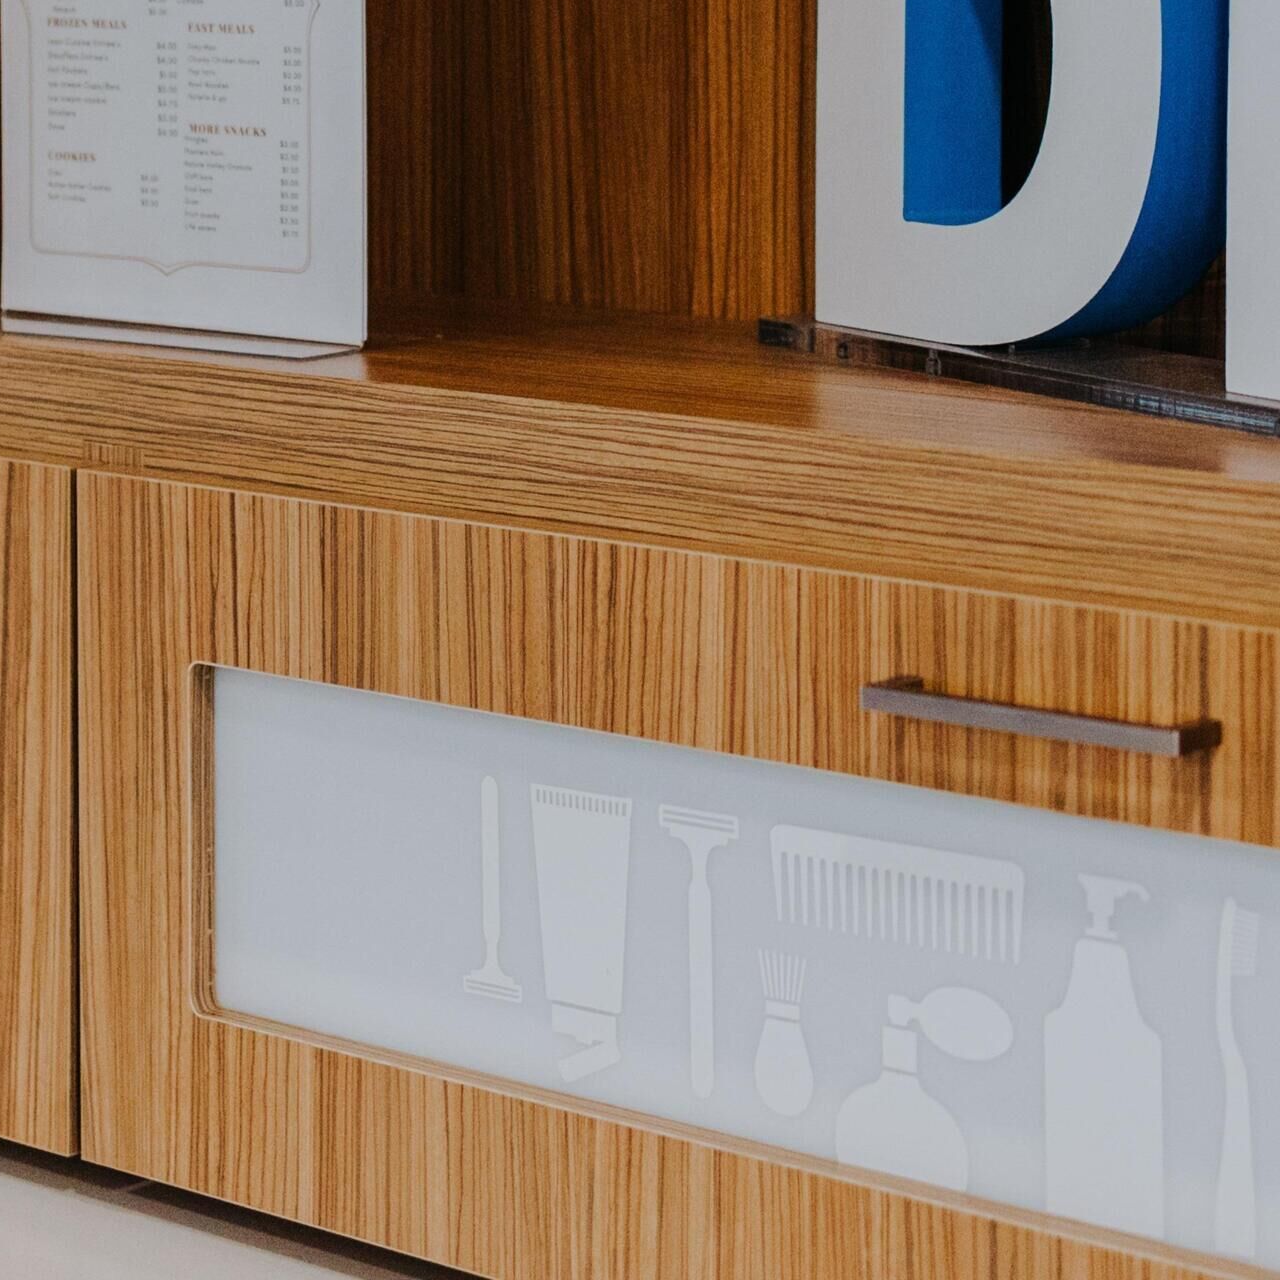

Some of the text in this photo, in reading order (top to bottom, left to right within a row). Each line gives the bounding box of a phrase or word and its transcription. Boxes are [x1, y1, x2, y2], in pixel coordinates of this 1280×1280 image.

[47, 17, 127, 31] FROZEN MEALS
[187, 22, 256, 36] FAST MEALS
[189, 123, 268, 138] MORE SNACKS
